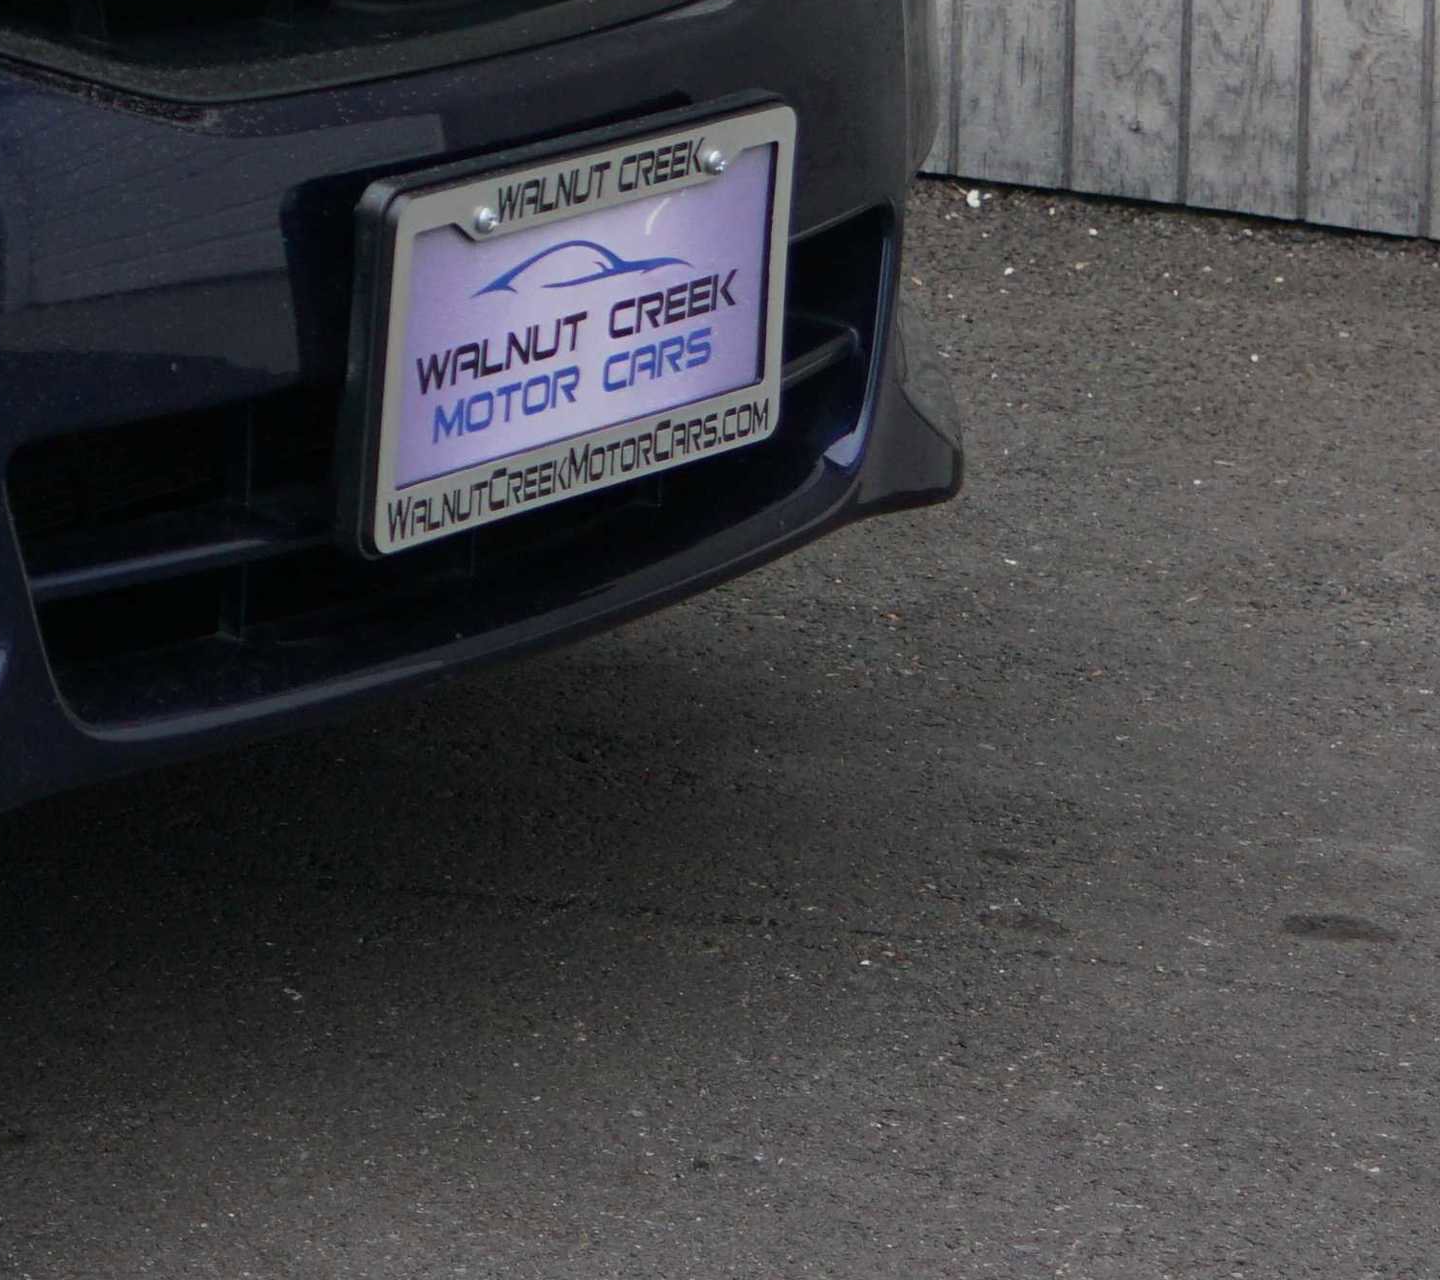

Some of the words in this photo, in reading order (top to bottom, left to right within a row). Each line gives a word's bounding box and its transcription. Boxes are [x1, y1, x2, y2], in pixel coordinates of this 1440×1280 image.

[497, 163, 612, 223] WALNUT
[618, 137, 705, 192] CREEK
[416, 311, 588, 395] WALNUT
[608, 268, 738, 339] CREEK
[432, 366, 580, 444] MOTOR
[602, 327, 713, 392] CARS
